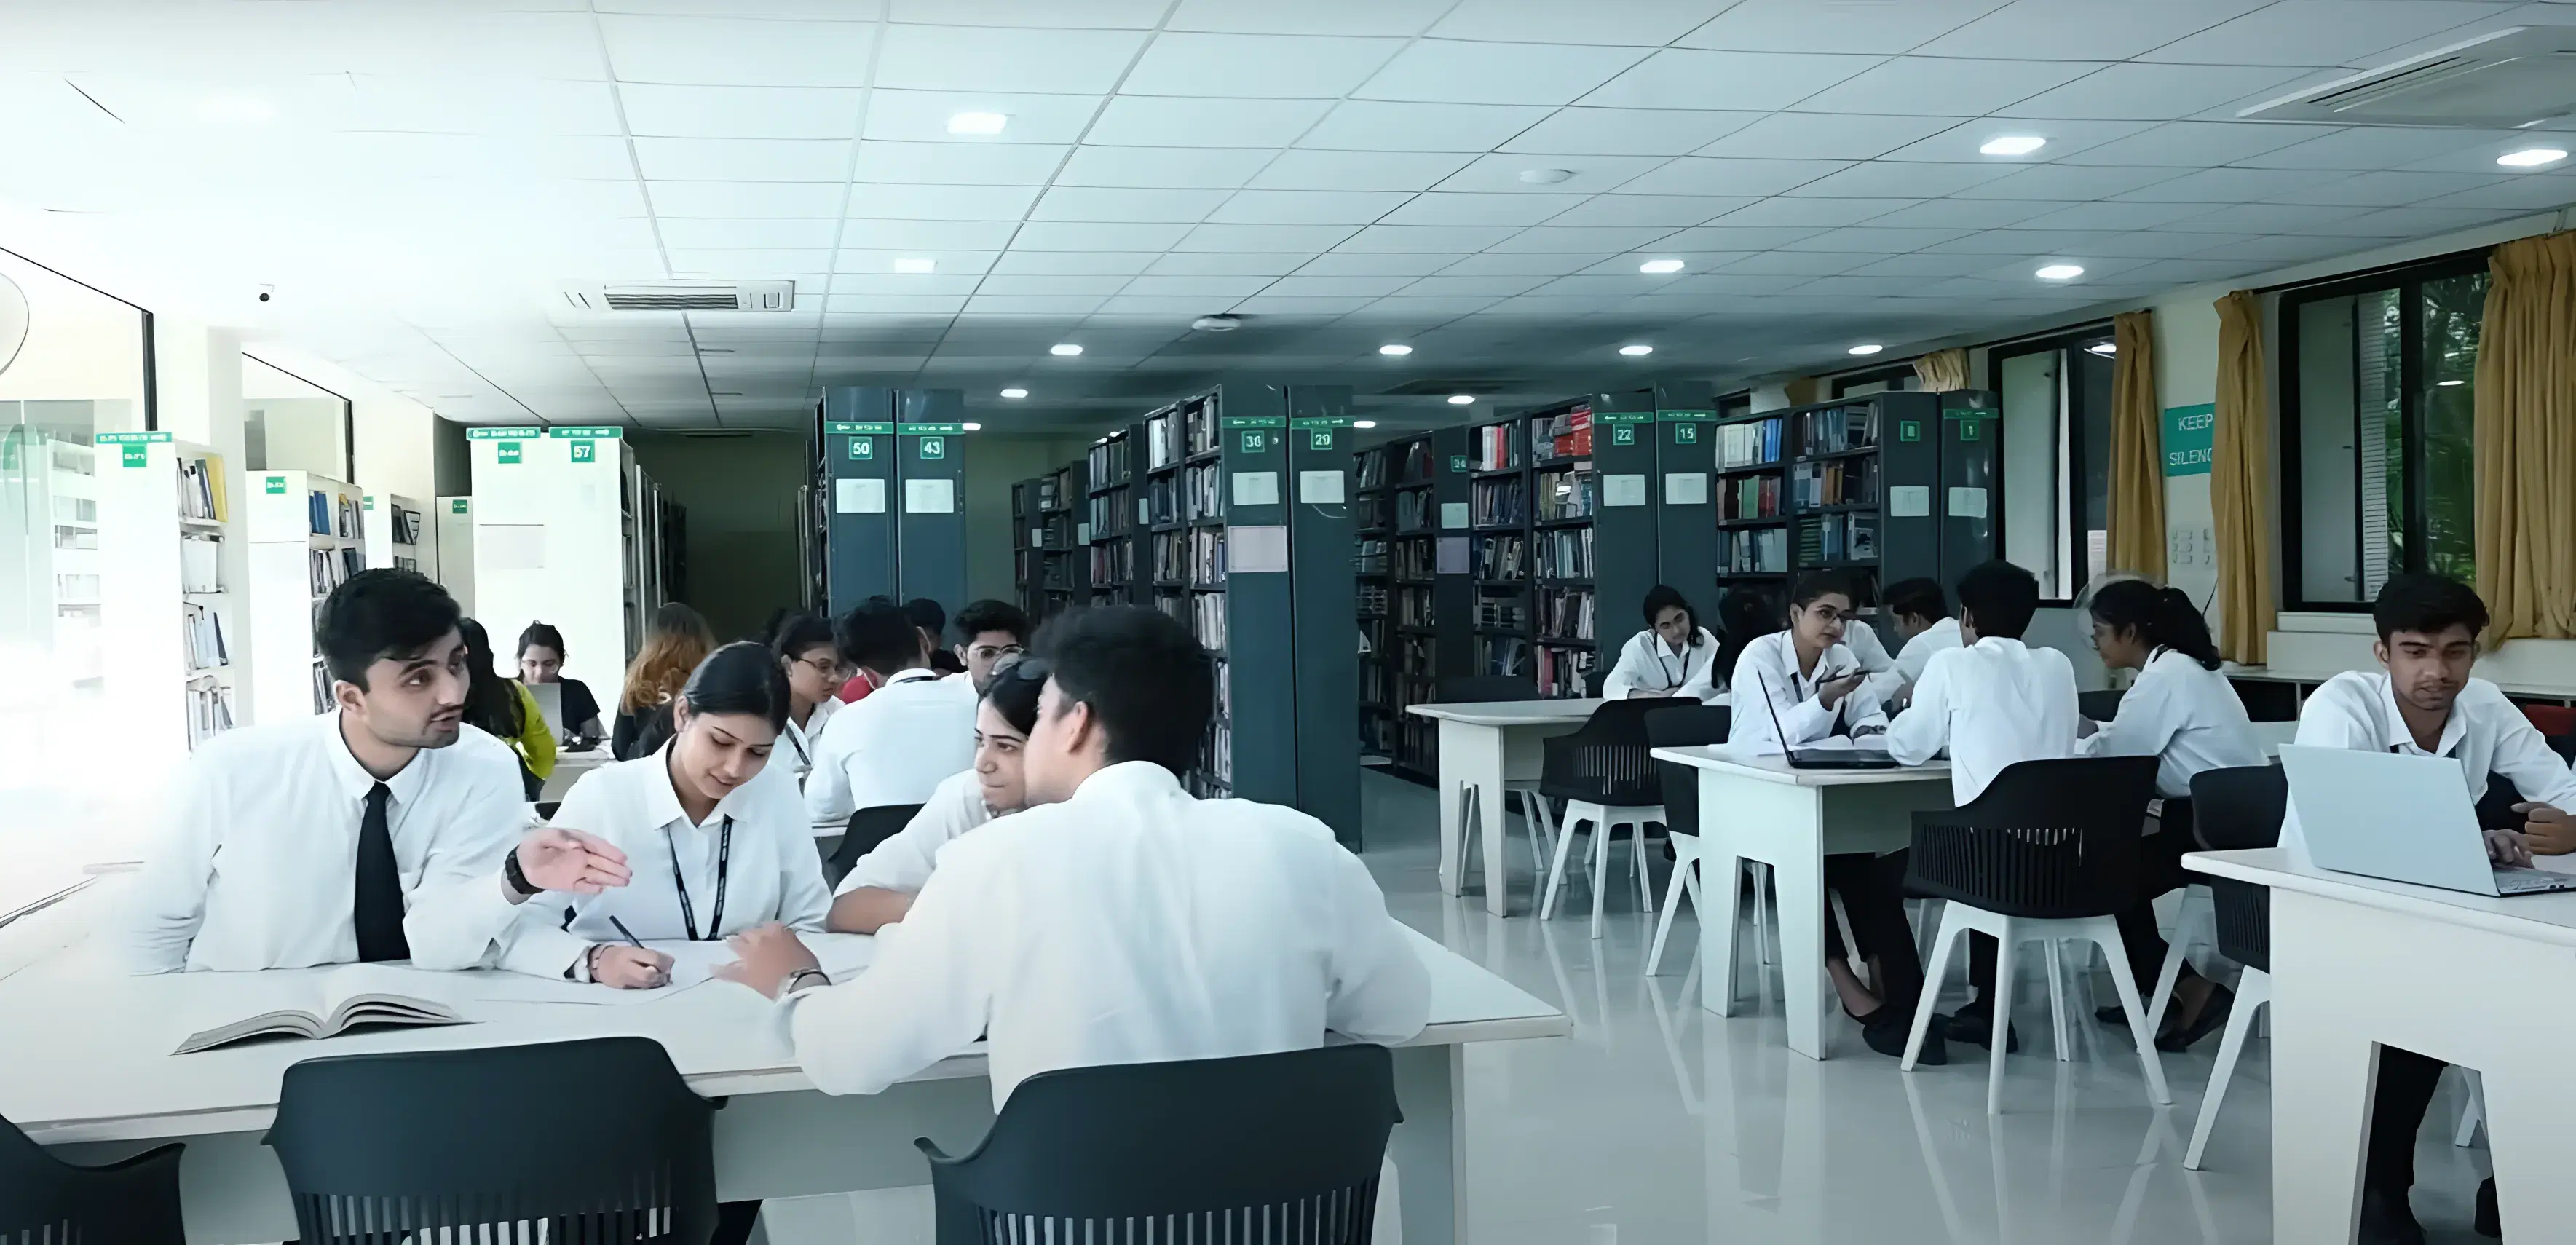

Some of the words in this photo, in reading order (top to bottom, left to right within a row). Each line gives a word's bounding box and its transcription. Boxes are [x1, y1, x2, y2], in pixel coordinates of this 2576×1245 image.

[2178, 413, 2213, 431] KEEP
[1617, 429, 1631, 440] 22
[1680, 427, 1694, 440] 15
[574, 446, 590, 458] 57
[853, 442, 869, 455] 50
[924, 441, 940, 454] 43
[2169, 448, 2213, 465] SILENC
